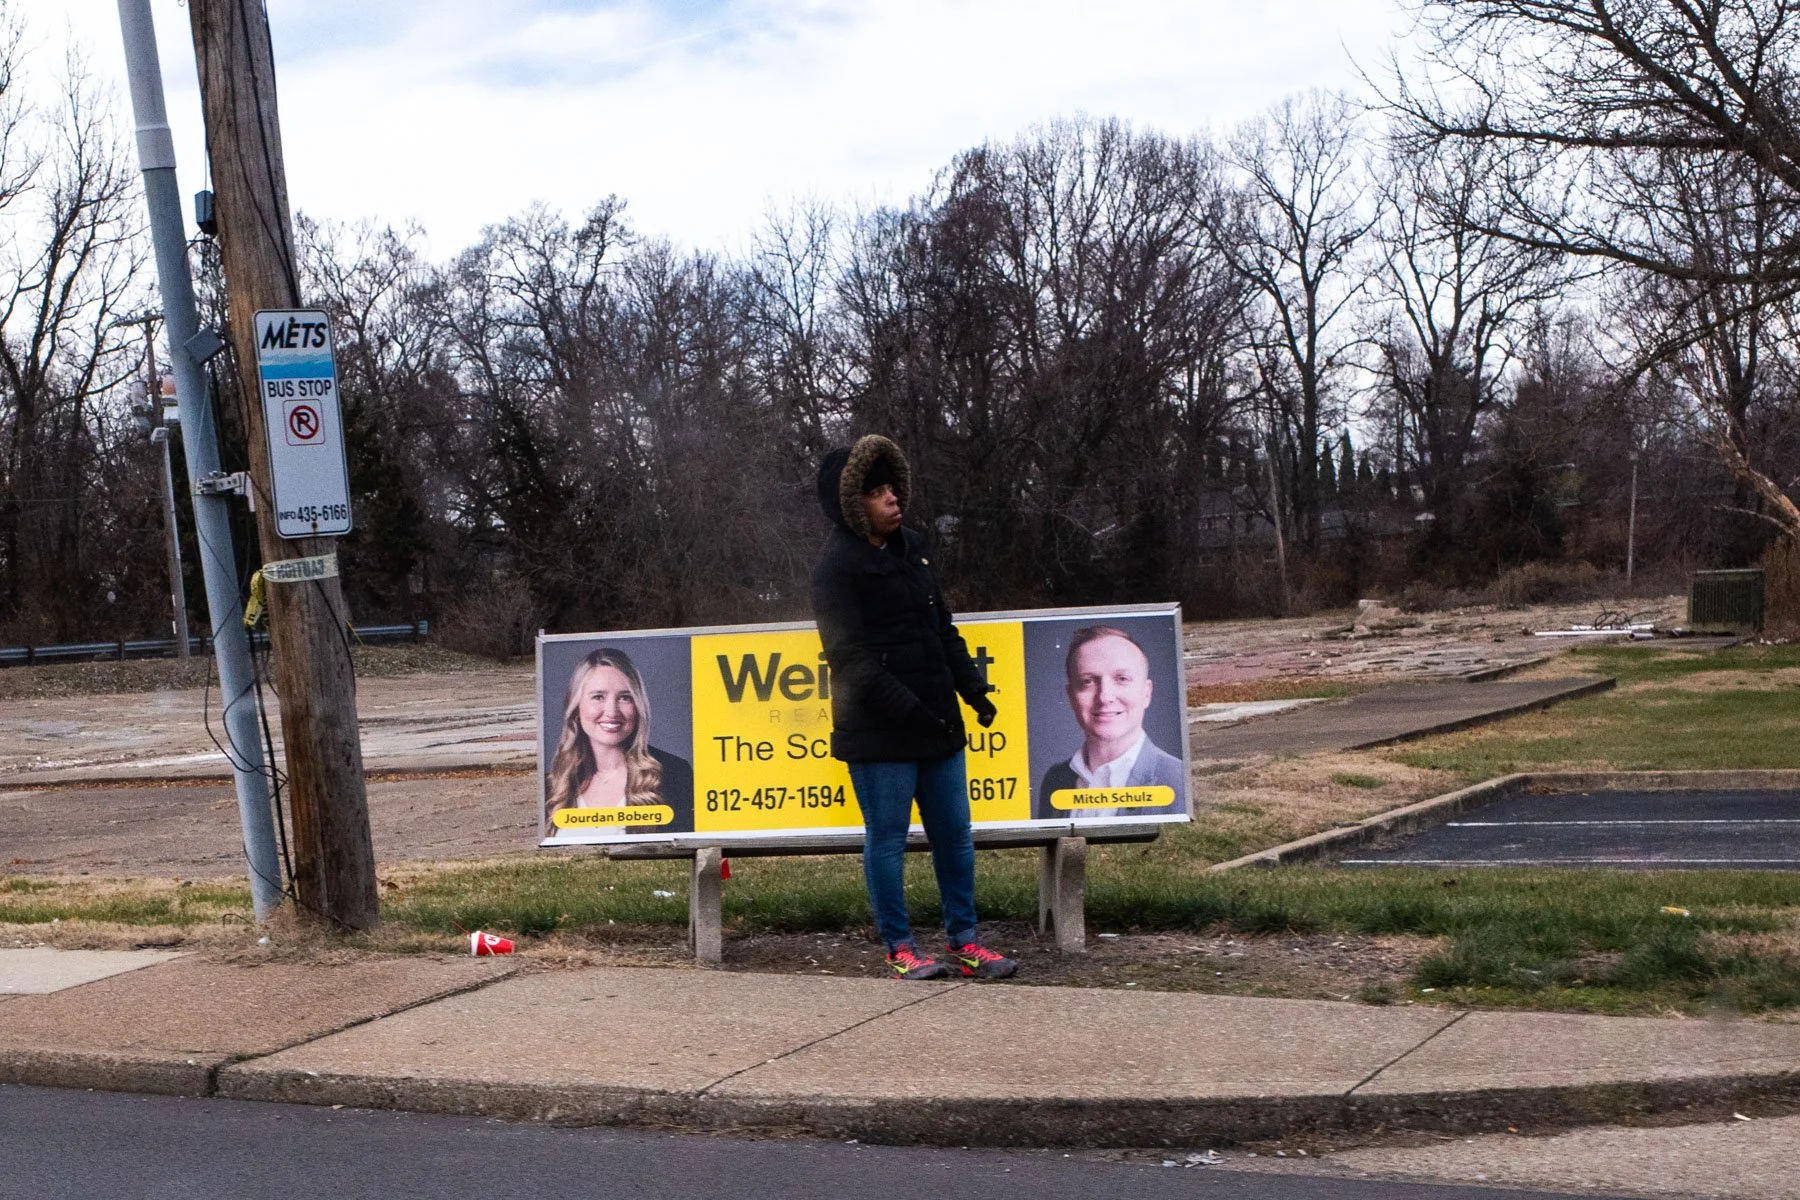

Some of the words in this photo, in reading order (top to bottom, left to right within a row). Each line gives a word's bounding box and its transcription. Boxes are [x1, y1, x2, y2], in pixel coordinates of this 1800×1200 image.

[261, 320, 327, 350] METS
[267, 381, 295, 399] BUS
[298, 379, 332, 397] STOP
[279, 511, 297, 520] INFO
[298, 504, 347, 522] 435-6166
[713, 735, 774, 762] The
[706, 785, 846, 812] 812-457-1594
[1073, 793, 1108, 804] Mitch
[1111, 791, 1152, 803] Schulz
[564, 813, 614, 823] Jourdan
[617, 811, 662, 823] Boberg
